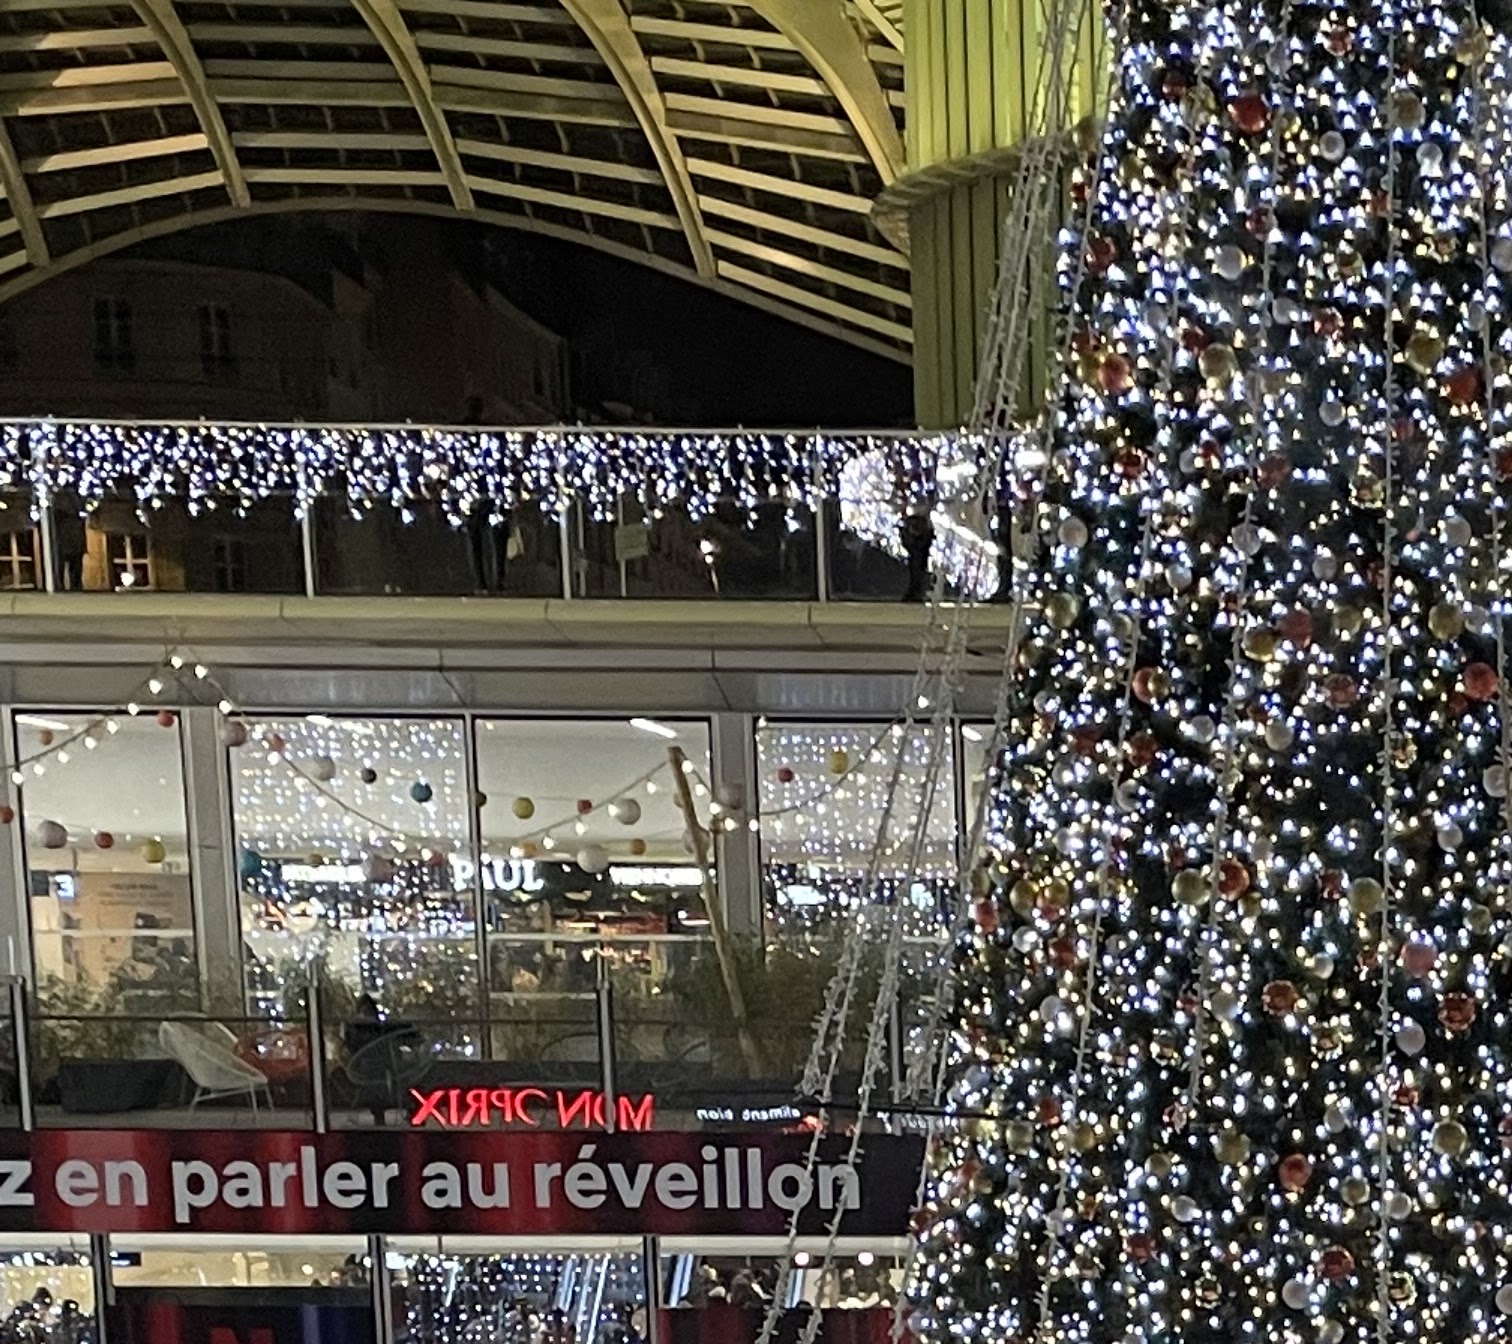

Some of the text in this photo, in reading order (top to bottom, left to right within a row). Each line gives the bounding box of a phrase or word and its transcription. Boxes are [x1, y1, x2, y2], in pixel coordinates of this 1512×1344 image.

[452, 858, 544, 891] PAUL
[54, 1160, 148, 1207] en
[172, 1145, 399, 1224] parler
[420, 1160, 510, 1209] au
[533, 1143, 861, 1210] réveillon
